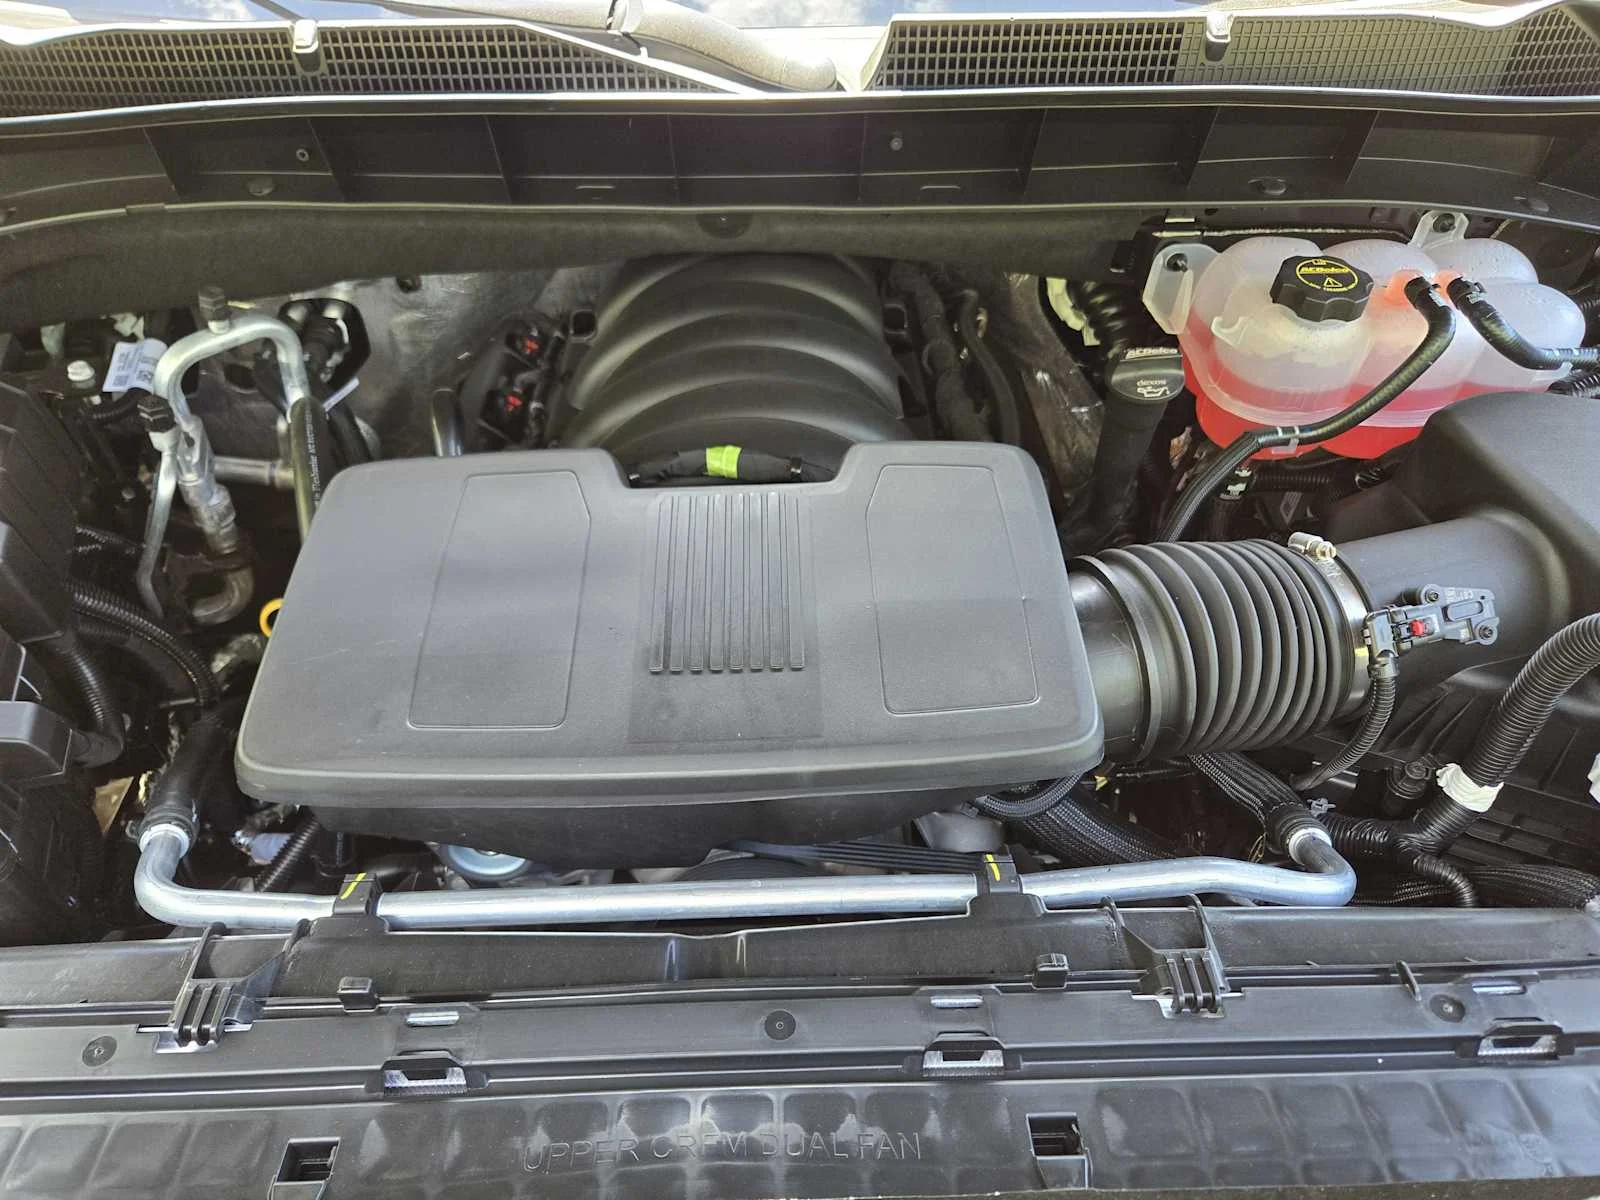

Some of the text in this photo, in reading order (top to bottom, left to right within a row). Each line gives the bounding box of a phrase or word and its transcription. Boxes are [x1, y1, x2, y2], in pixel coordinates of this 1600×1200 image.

[522, 1136, 640, 1172] UPPER
[759, 1131, 849, 1160] DUAL
[857, 1130, 922, 1160] FAN
